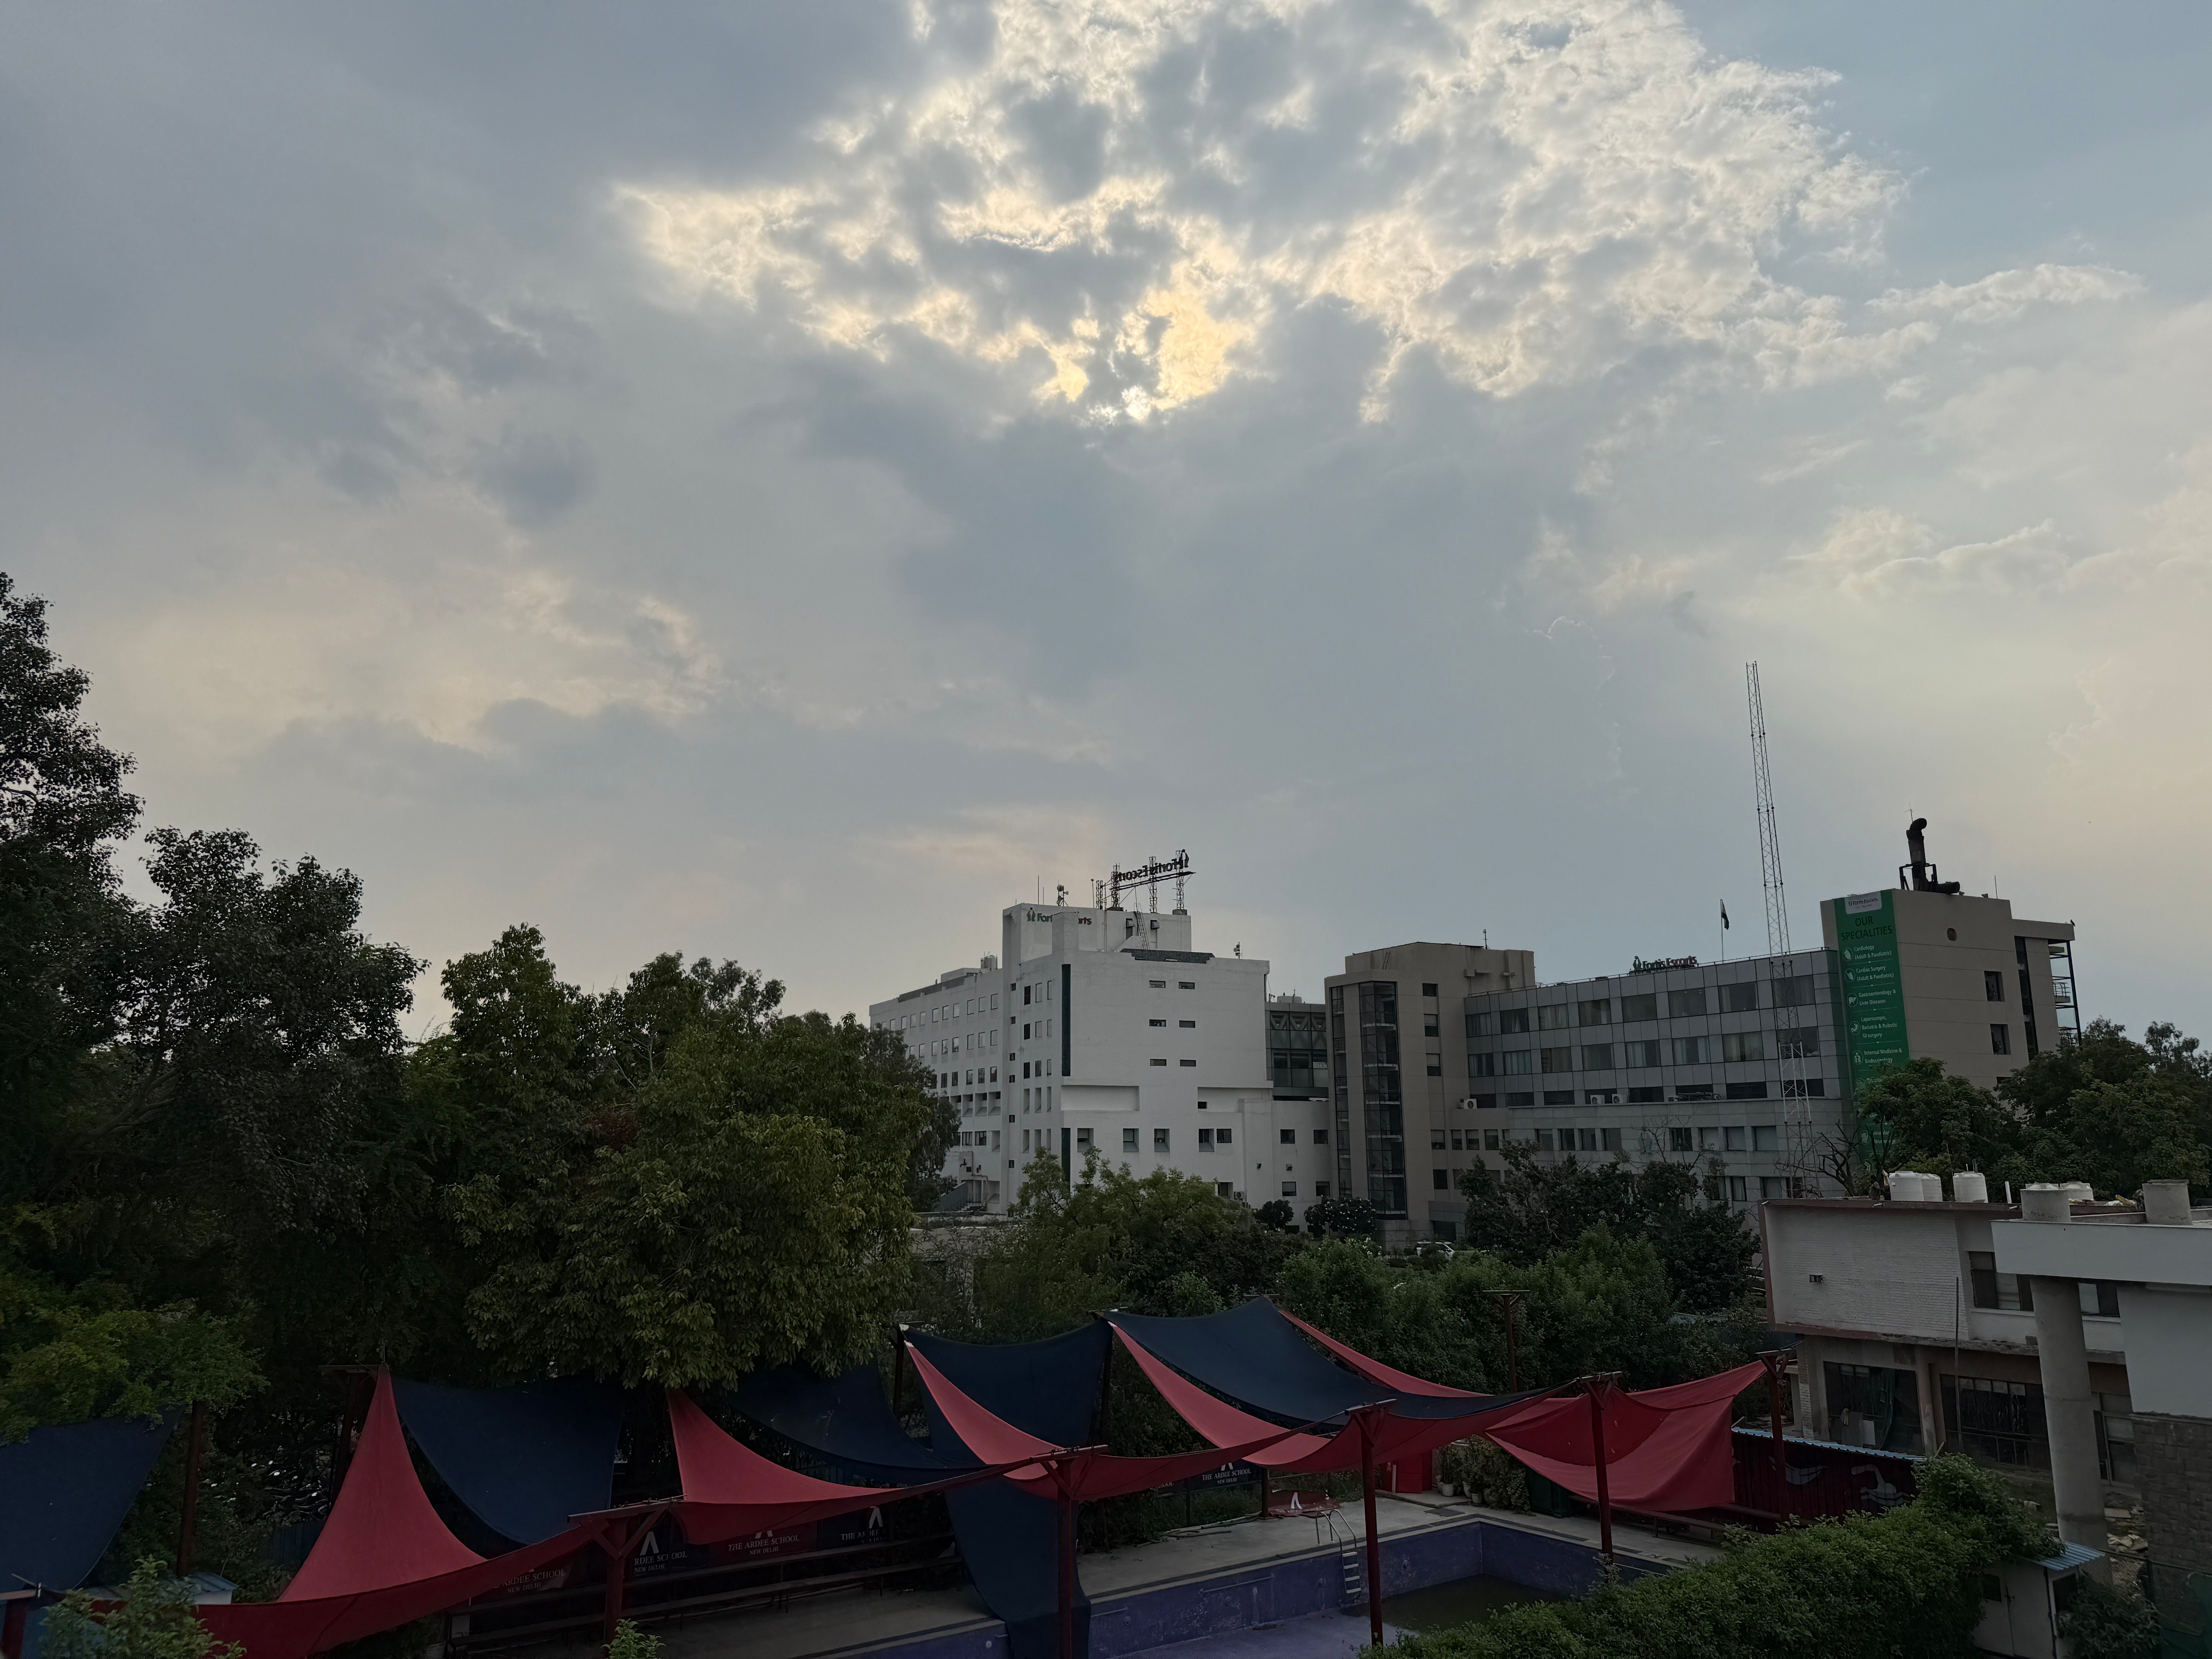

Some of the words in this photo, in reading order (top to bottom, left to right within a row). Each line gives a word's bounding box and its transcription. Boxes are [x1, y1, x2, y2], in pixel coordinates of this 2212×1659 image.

[1855, 916, 1873, 926] OUR
[1841, 925, 1893, 941] SPECIALITIES
[1642, 959, 1666, 970] Fortis
[1666, 956, 1697, 967] Escorts
[728, 1543, 742, 1551] THE
[744, 1539, 769, 1549] ARDEE
[771, 1535, 799, 1545] SCHOOL
[634, 1556, 654, 1565] RDEE
[532, 1569, 566, 1580] SCHOOL
